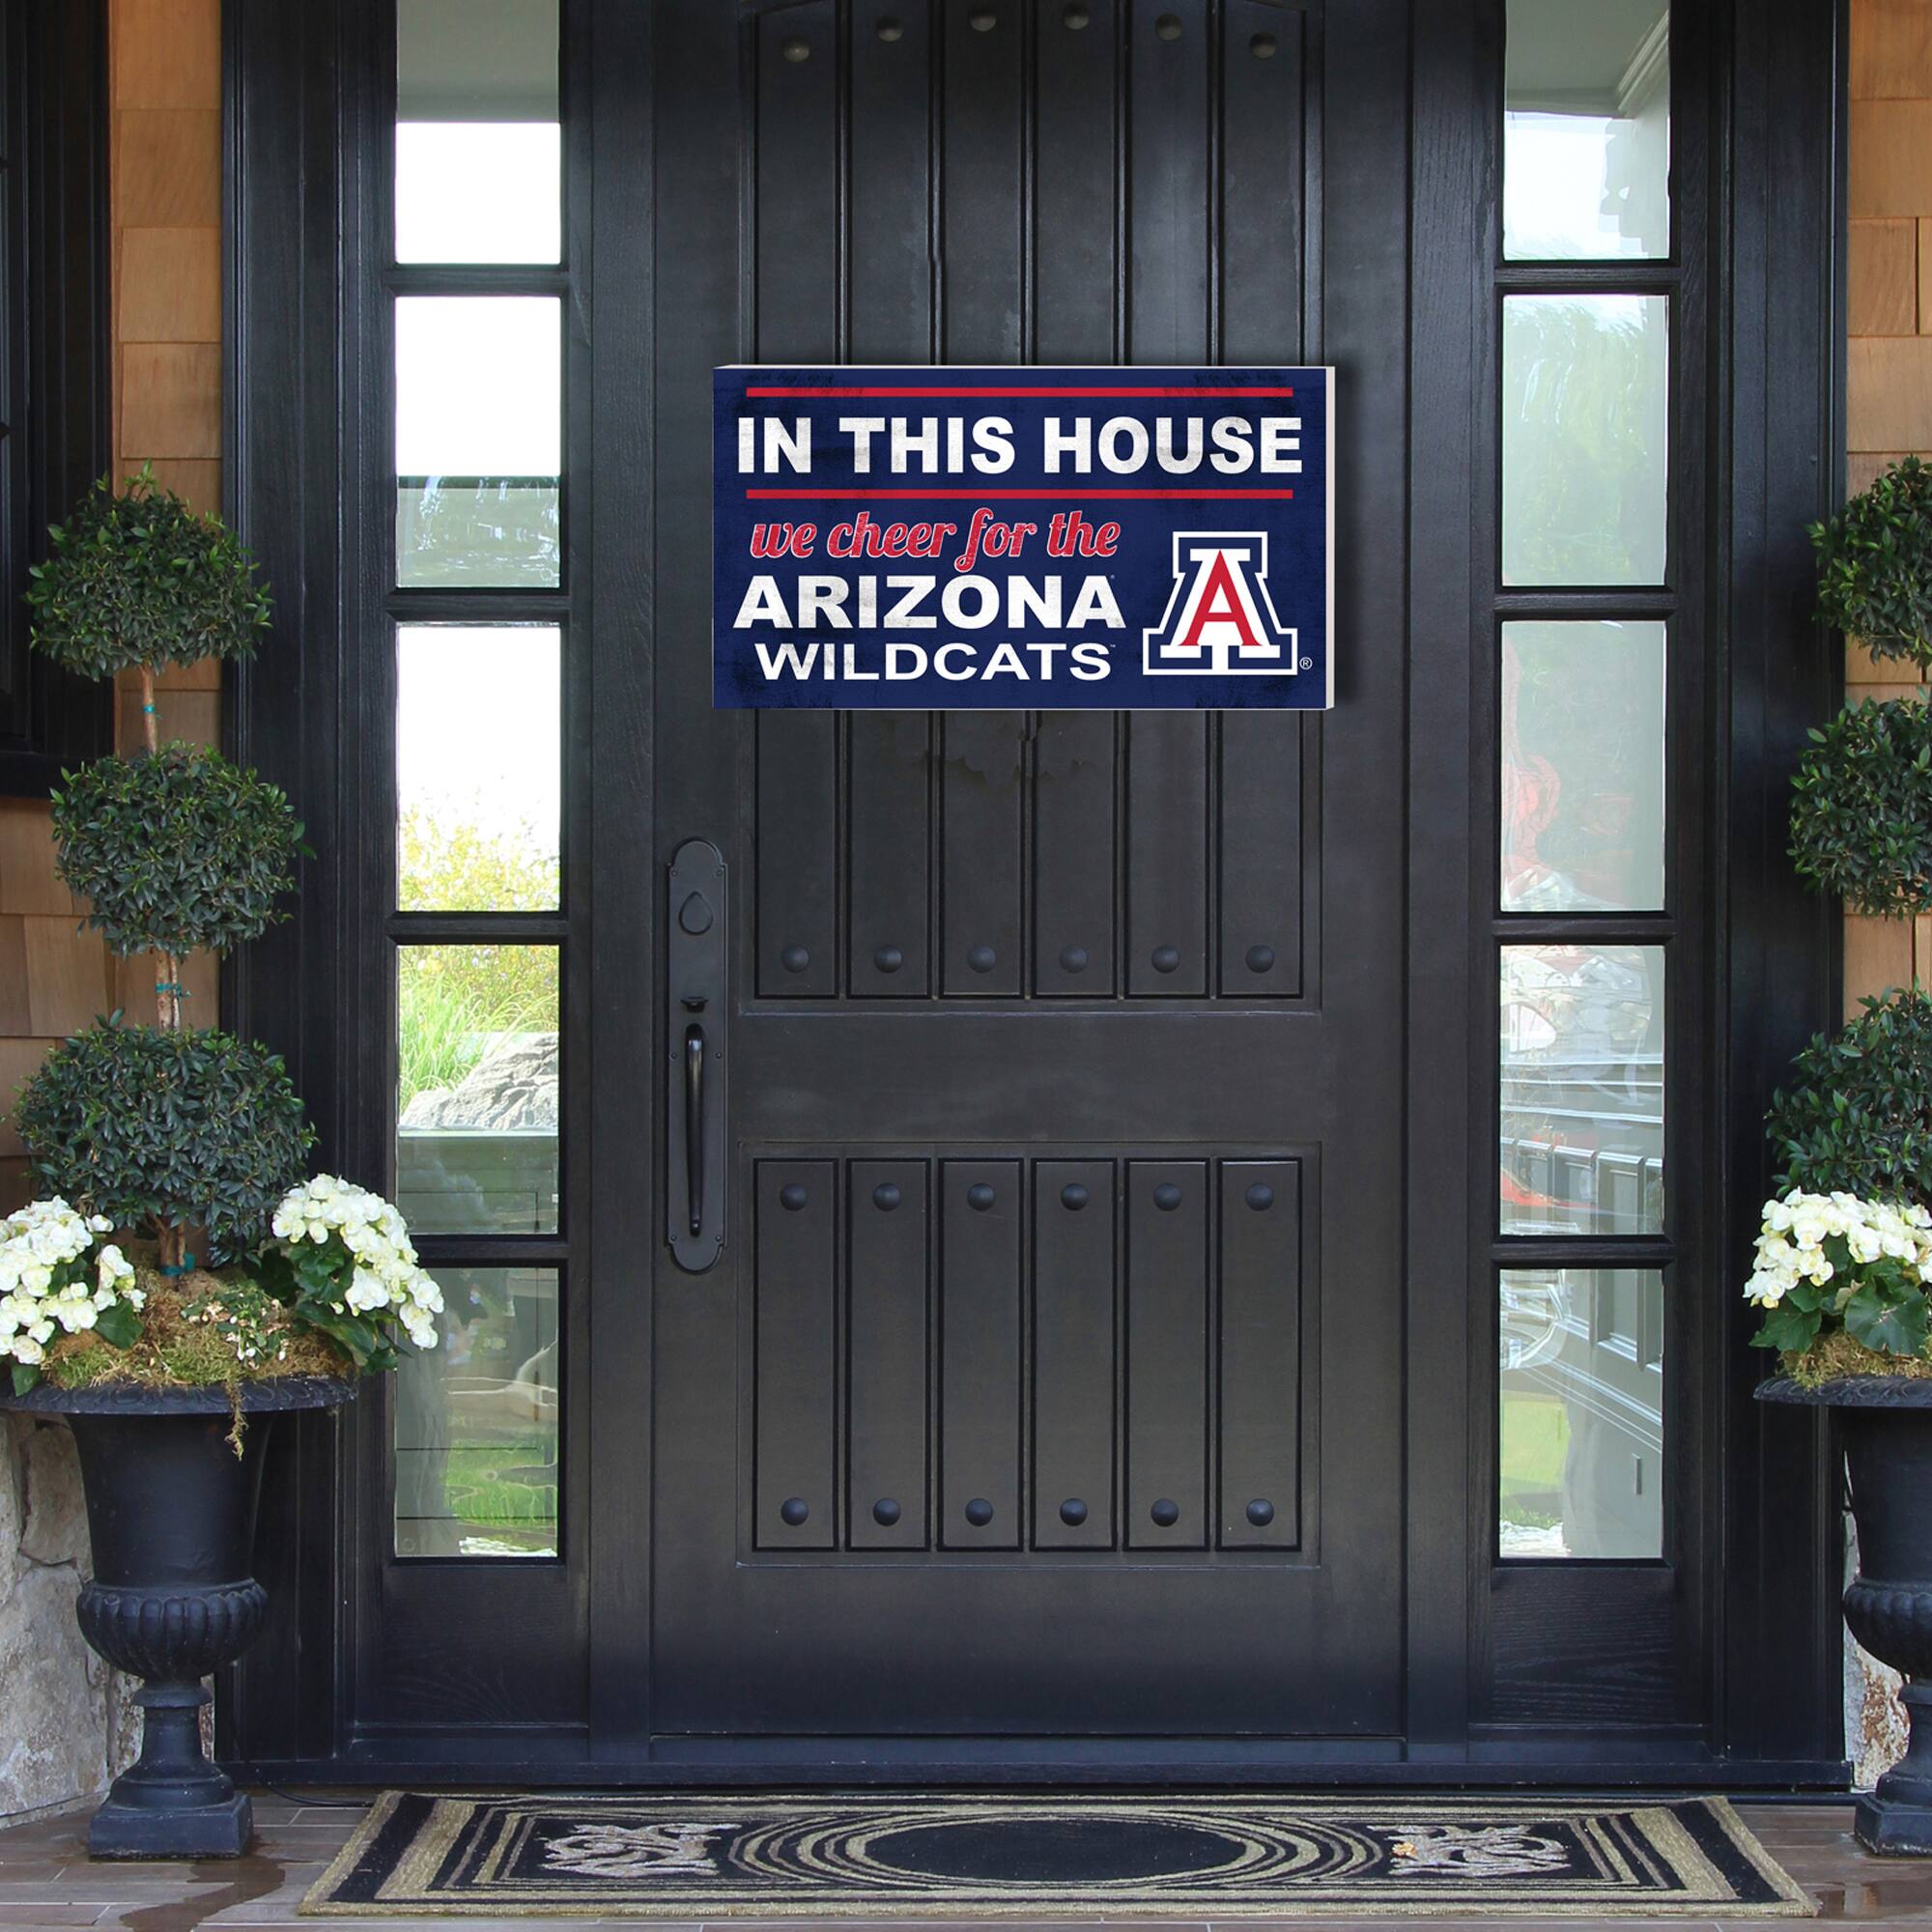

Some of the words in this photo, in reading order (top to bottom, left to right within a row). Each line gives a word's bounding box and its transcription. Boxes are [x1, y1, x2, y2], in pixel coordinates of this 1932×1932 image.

[738, 417, 811, 472] IN
[839, 416, 1014, 473] THIS
[1044, 416, 1302, 473] HOUSE
[750, 522, 815, 557] we
[827, 511, 957, 557] cheer
[955, 507, 1037, 572] for
[1047, 510, 1121, 556] the
[733, 575, 1126, 628] ARIZONA
[1143, 531, 1297, 675] A
[754, 642, 1111, 680] WILDCATS
